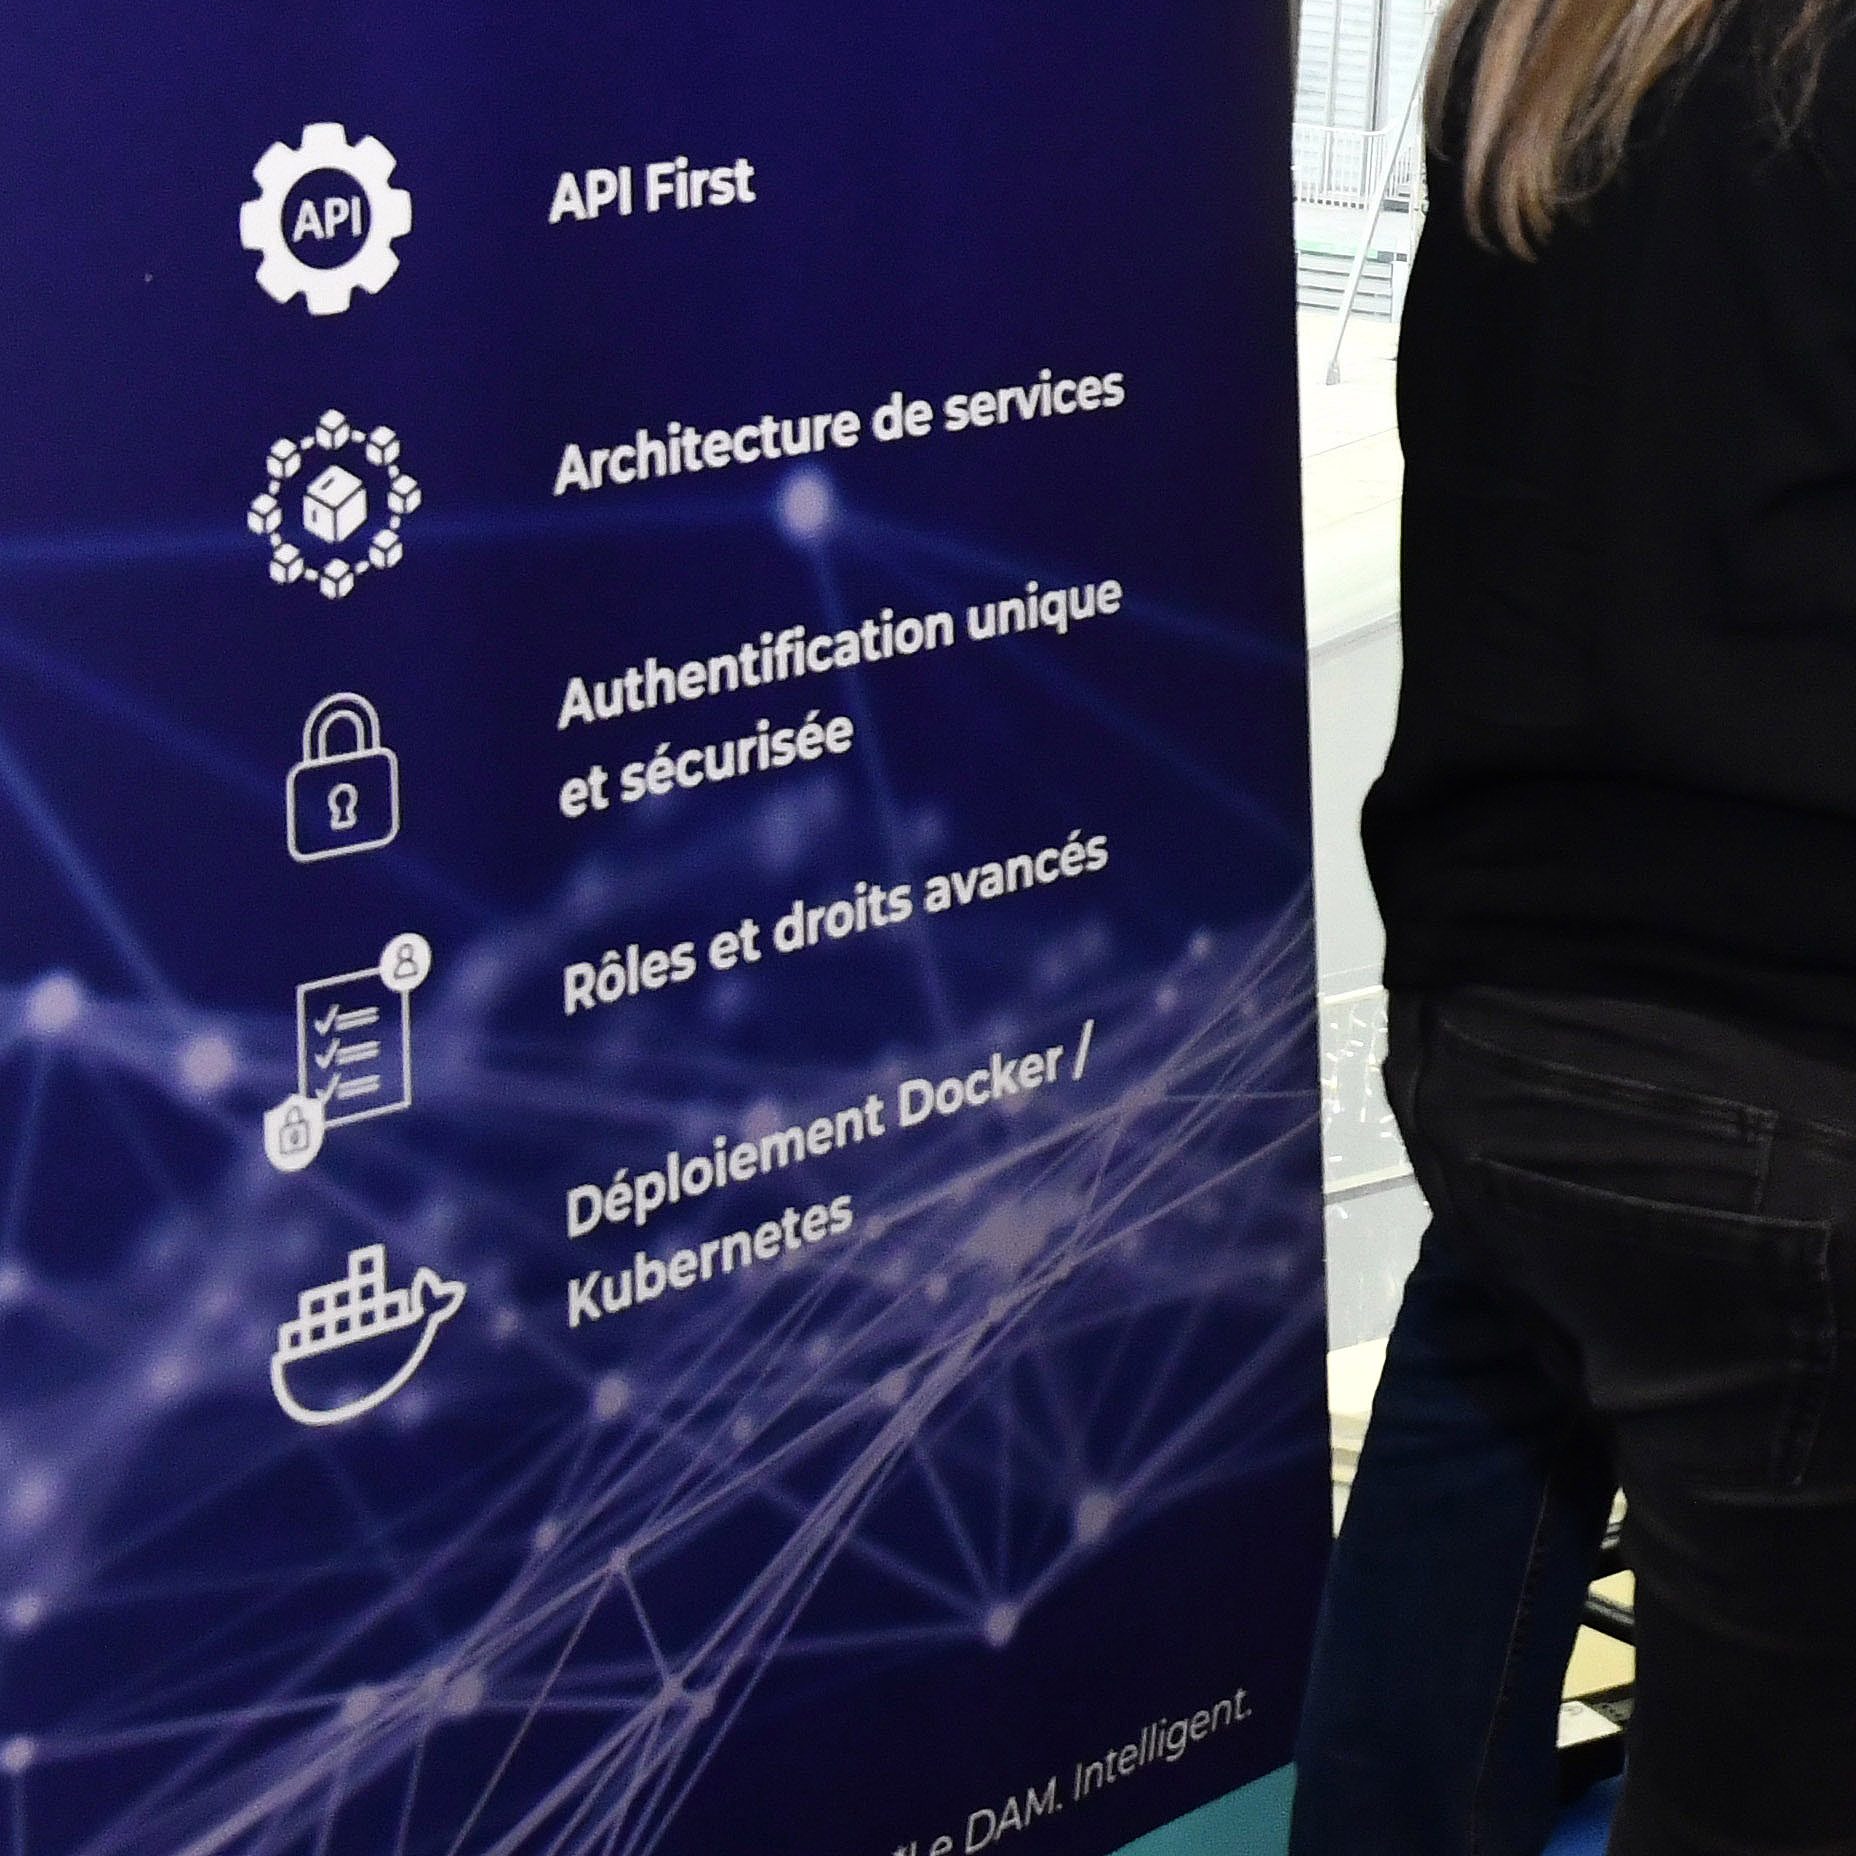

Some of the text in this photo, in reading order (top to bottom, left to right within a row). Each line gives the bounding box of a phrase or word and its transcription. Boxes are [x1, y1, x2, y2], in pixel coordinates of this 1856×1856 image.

[293, 196, 361, 242] API
[549, 156, 756, 223] API First
[554, 369, 1124, 495] Architecture de services
[558, 579, 1122, 731] Authentification unique
[560, 710, 853, 817] et sécurisée
[565, 830, 1108, 1015] Rôles et droits avancés
[568, 1020, 1094, 1239] Déploiement Docker /
[569, 1195, 853, 1327] Kubernetes
[965, 1776, 1062, 1854] DAM.
[1074, 1688, 1252, 1801] Intelligent.
